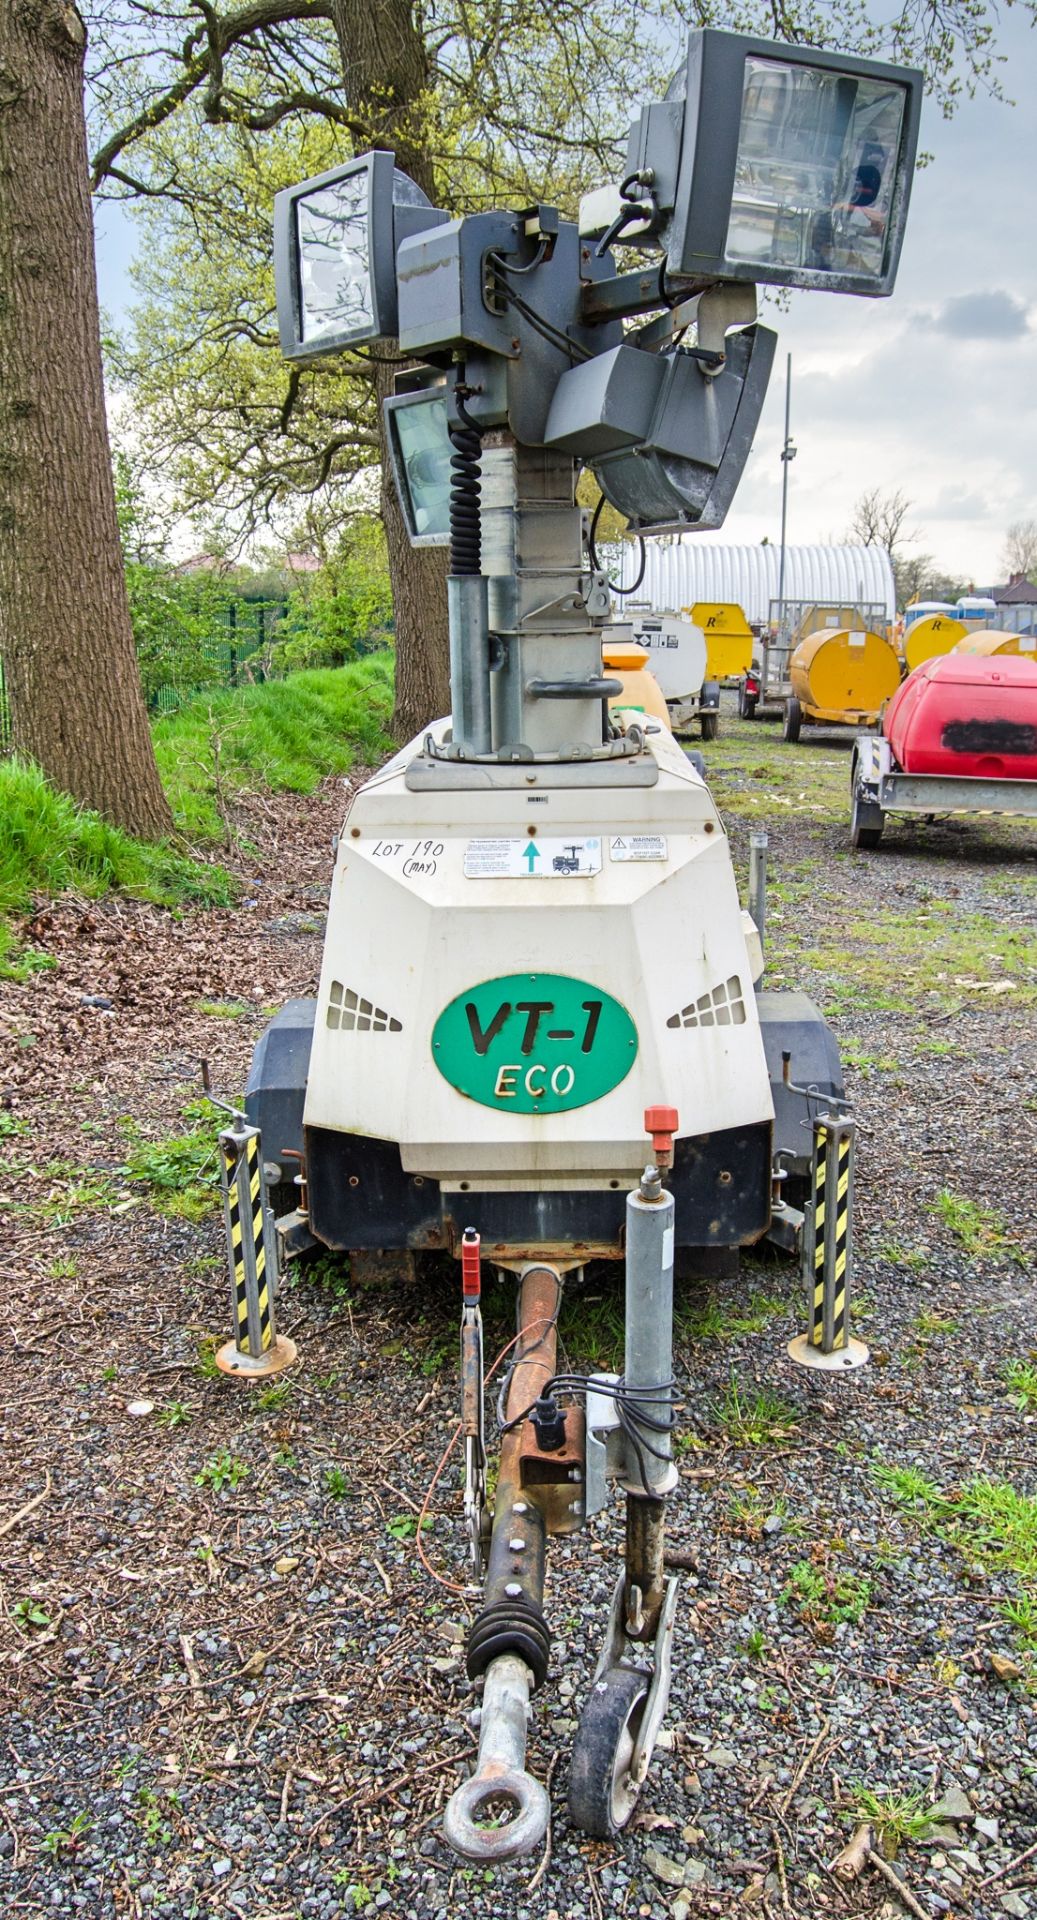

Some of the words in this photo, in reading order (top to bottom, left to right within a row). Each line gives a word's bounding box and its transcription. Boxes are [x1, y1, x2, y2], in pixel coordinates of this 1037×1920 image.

[372, 841, 405, 857] LOT
[412, 841, 445, 857] 190
[402, 858, 436, 878] (MAY)
[464, 1001, 603, 1056] VT-1
[494, 1064, 576, 1098] ECO
